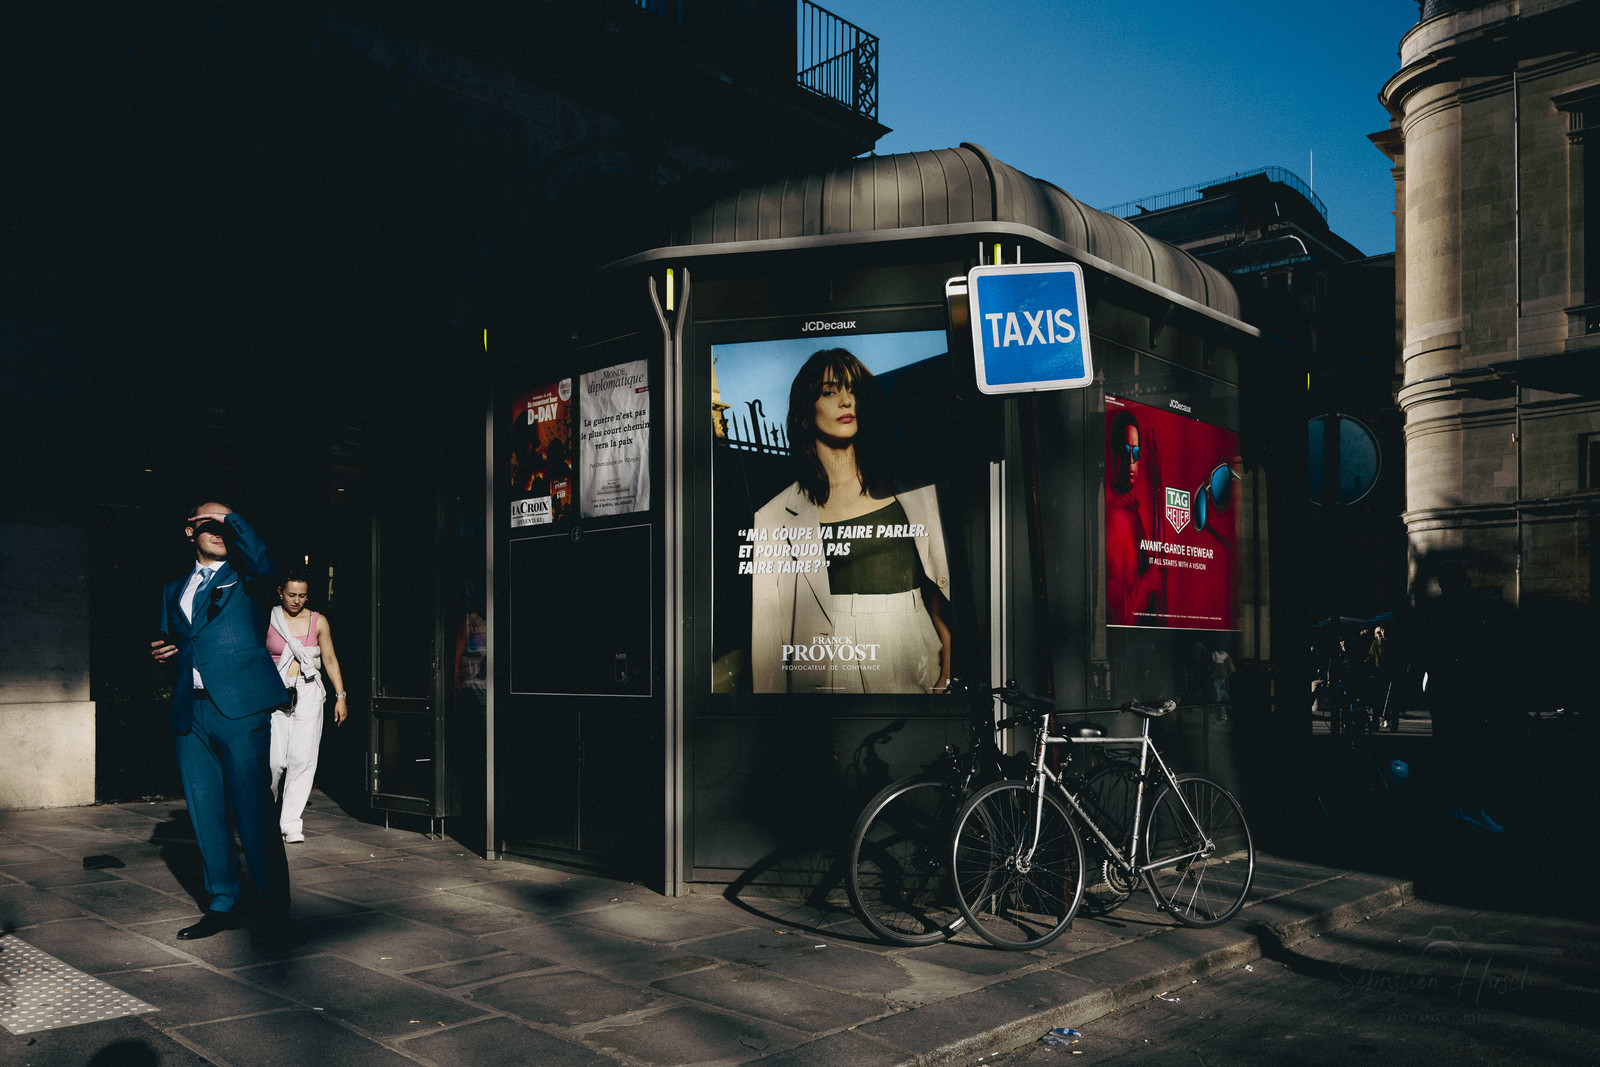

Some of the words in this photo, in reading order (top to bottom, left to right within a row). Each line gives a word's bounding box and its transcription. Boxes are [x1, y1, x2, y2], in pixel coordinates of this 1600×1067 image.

[801, 320, 857, 332] JCDecaux
[985, 308, 1076, 348] TAXIS
[587, 374, 645, 396] diplomatique
[527, 403, 559, 426] D-DAY
[1168, 398, 1192, 413] JCDecaux
[584, 419, 592, 427] La
[593, 416, 615, 427] guerre
[615, 411, 634, 422] n'est
[634, 409, 647, 420] pas
[580, 432, 587, 440] le
[588, 430, 602, 441] plus
[603, 426, 622, 436] court
[623, 421, 650, 433] chemin
[594, 442, 609, 450] vers
[610, 439, 617, 447] la
[618, 437, 633, 448] paix
[1167, 490, 1189, 508] TAG
[1167, 508, 1190, 531] HEUER
[738, 526, 768, 542] “MA
[772, 526, 813, 541] COUPE
[817, 525, 834, 540] VA
[836, 525, 873, 539] FAIRE
[875, 524, 929, 539] PARLER.
[738, 544, 753, 559] ET
[755, 543, 825, 558] POURQUOI
[826, 542, 851, 556] PAS
[1139, 538, 1186, 556] AVANT-GARDE
[1186, 545, 1214, 560] EYEWEAR
[738, 561, 774, 575] FAIRE
[1154, 557, 1163, 566] ALL
[1162, 558, 1178, 568] STARTS
[1178, 560, 1189, 569] WITH
[1194, 561, 1207, 571] VISION
[812, 636, 853, 645] FRANCK
[780, 644, 881, 662] PROVOST
